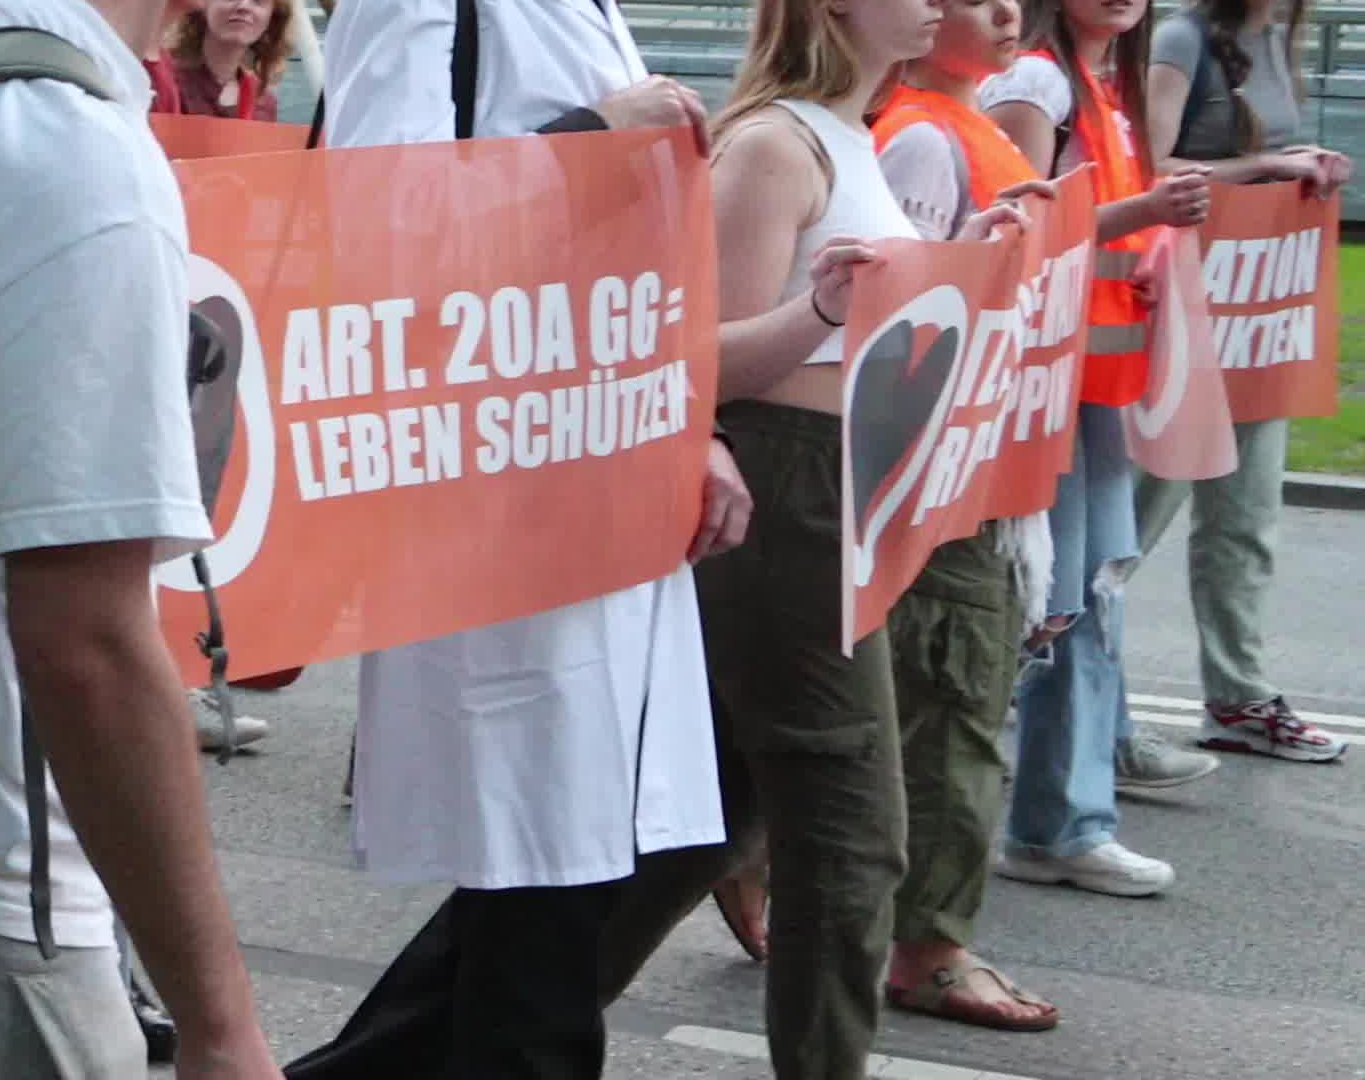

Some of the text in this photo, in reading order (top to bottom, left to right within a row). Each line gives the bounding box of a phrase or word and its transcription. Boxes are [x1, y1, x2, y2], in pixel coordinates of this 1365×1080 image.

[281, 297, 428, 405] ART.
[439, 285, 577, 386] 20A
[289, 359, 688, 502] LEBEN SCHÜTZEN
